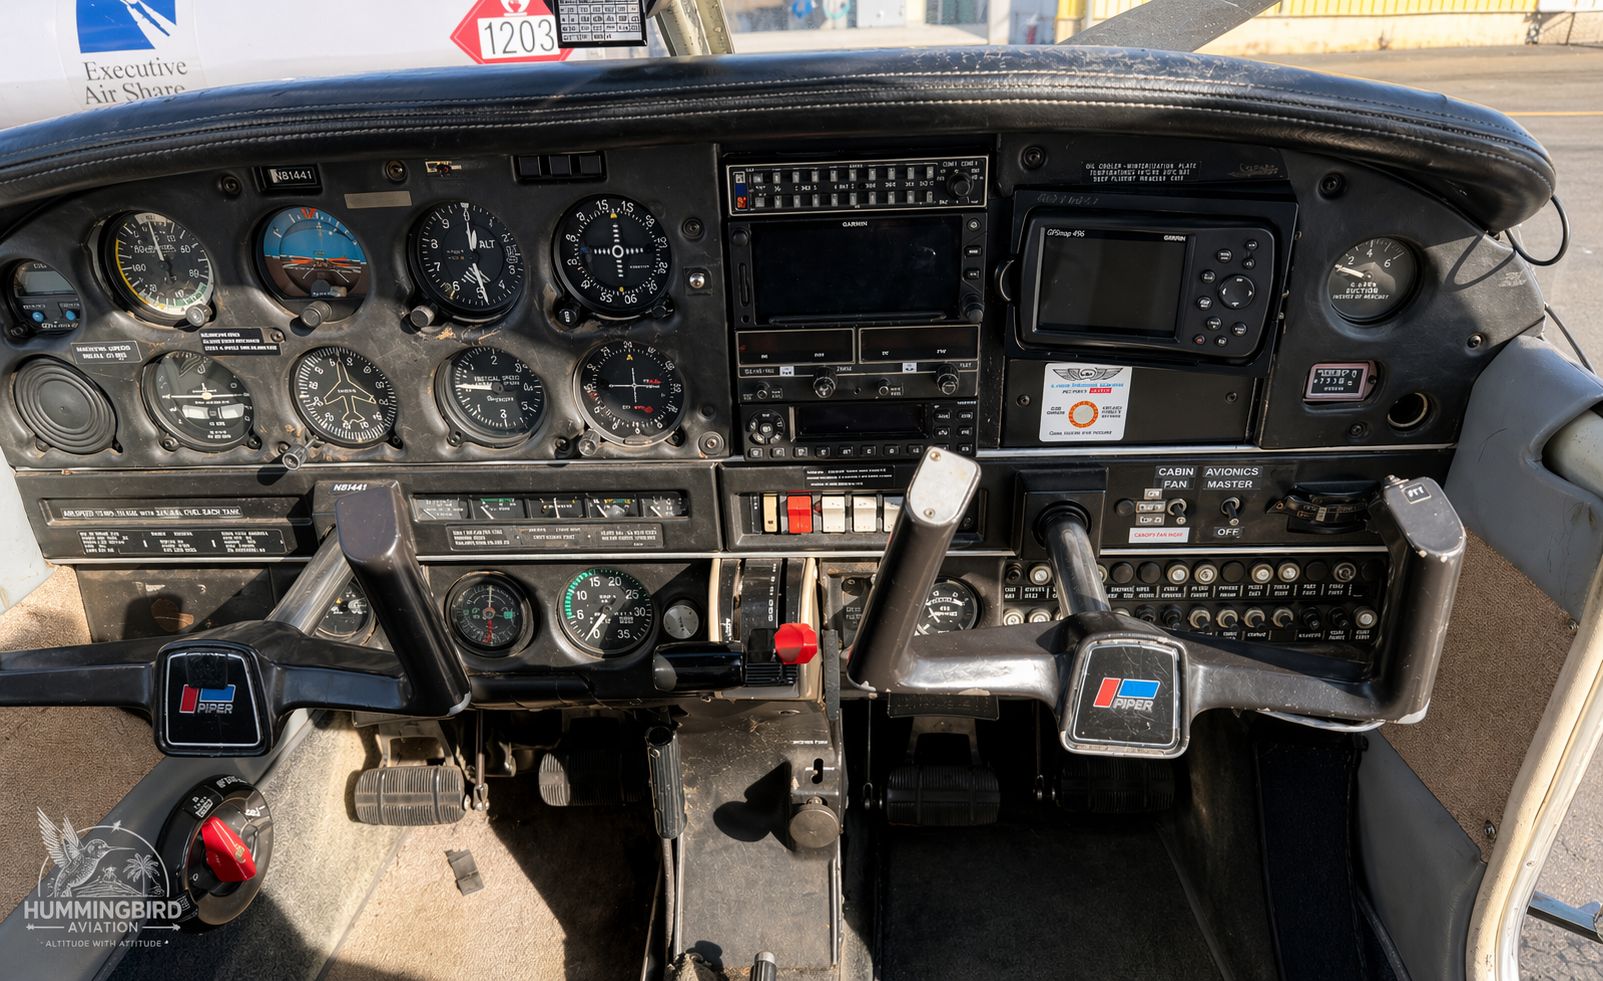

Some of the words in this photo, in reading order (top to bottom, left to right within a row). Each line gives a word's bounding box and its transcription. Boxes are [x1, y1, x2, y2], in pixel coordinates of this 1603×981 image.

[483, 18, 555, 55] 1203
[84, 57, 188, 81] Executive
[85, 84, 117, 105] Air
[122, 82, 186, 103] Share
[273, 170, 312, 181] N81441
[480, 240, 495, 249] ALT
[1348, 256, 1355, 266] 2
[1384, 259, 1391, 268] 6
[491, 356, 498, 365] 2
[1159, 467, 1194, 476] CABIN
[1206, 467, 1259, 476] AVIONICS
[1164, 481, 1187, 489] FAN
[1207, 480, 1253, 489] MASTER
[1217, 528, 1240, 537] OFF
[589, 576, 601, 588] 15
[608, 576, 622, 587] 20
[576, 590, 588, 601] 10
[634, 607, 646, 617] 30
[617, 629, 631, 639] 35
[198, 703, 233, 714] PIPER
[1113, 698, 1154, 712] PIPER
